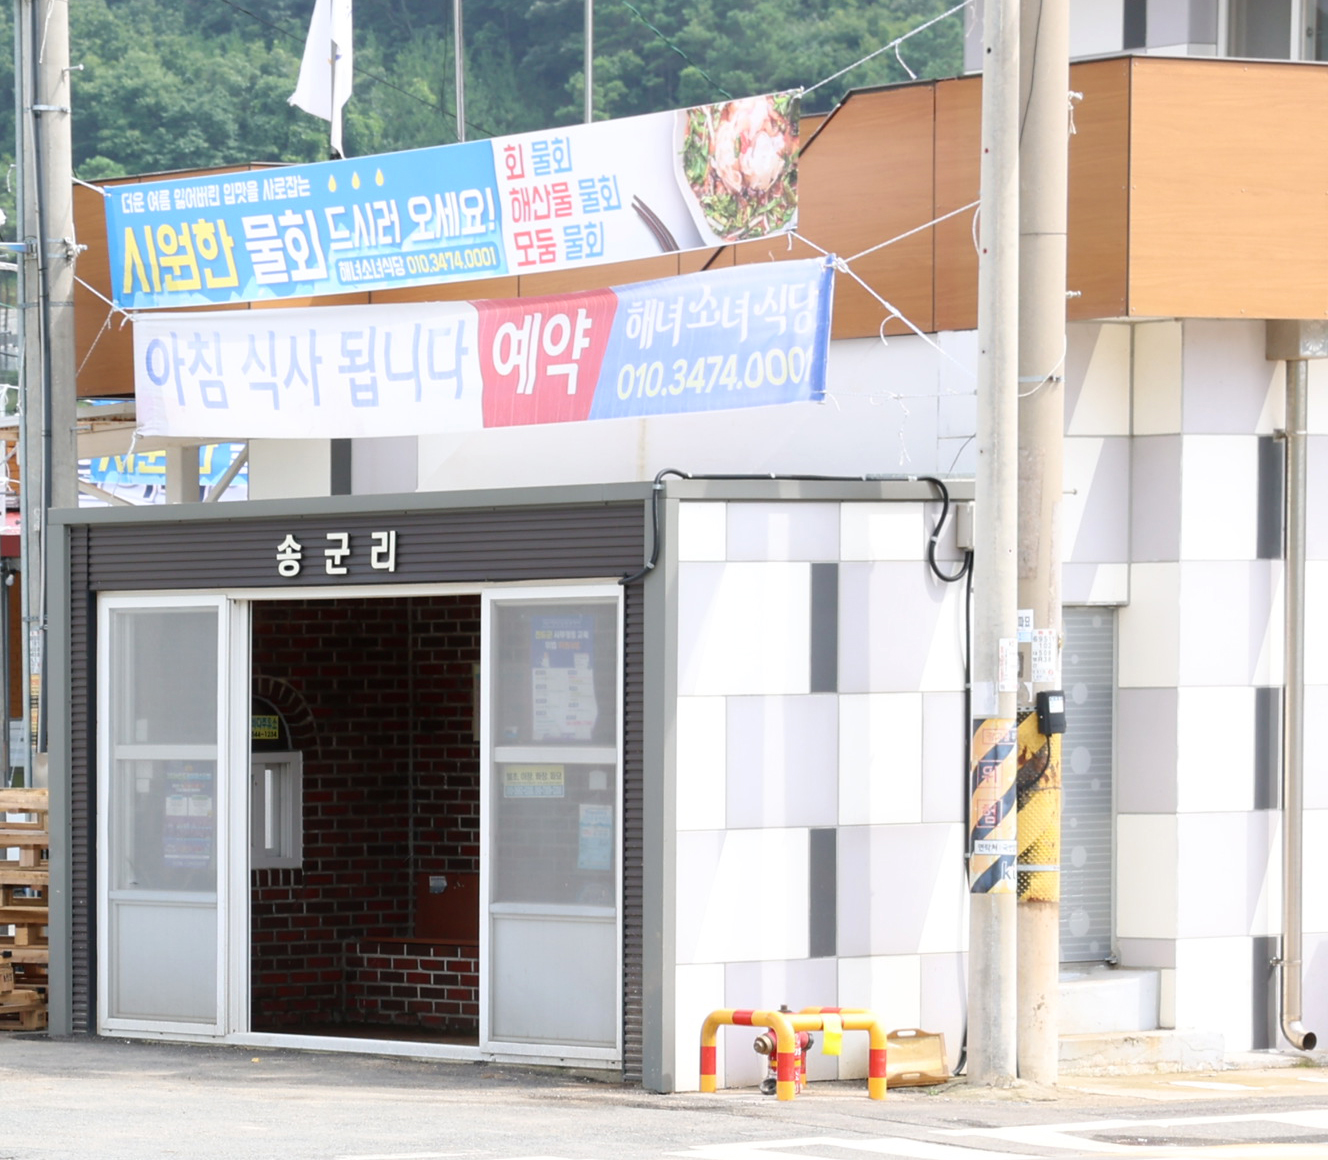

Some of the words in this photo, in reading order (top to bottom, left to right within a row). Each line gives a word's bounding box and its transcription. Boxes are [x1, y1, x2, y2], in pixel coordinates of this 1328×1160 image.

[503, 143, 525, 180] 회
[531, 136, 573, 177] 물회
[121, 191, 146, 214] 더운
[147, 189, 171, 212] 여름
[173, 185, 221, 210] 잃어버린
[223, 180, 259, 205] 입맛을
[262, 175, 311, 201] 사로잡는
[509, 181, 573, 223] 해산물
[578, 174, 622, 214] 물회
[123, 218, 239, 294] 시원한
[241, 209, 328, 284] 물회
[324, 199, 401, 250] 드시러
[407, 187, 495, 242] 오세요!
[513, 228, 557, 267] 모둠
[563, 221, 605, 261] 물회
[338, 255, 406, 283] 해녀소녀식당
[145, 330, 229, 409] 아침
[241, 328, 323, 410] 식사
[338, 319, 469, 408] 됩니다
[492, 307, 593, 395] 예약
[276, 530, 396, 577] 송군리
